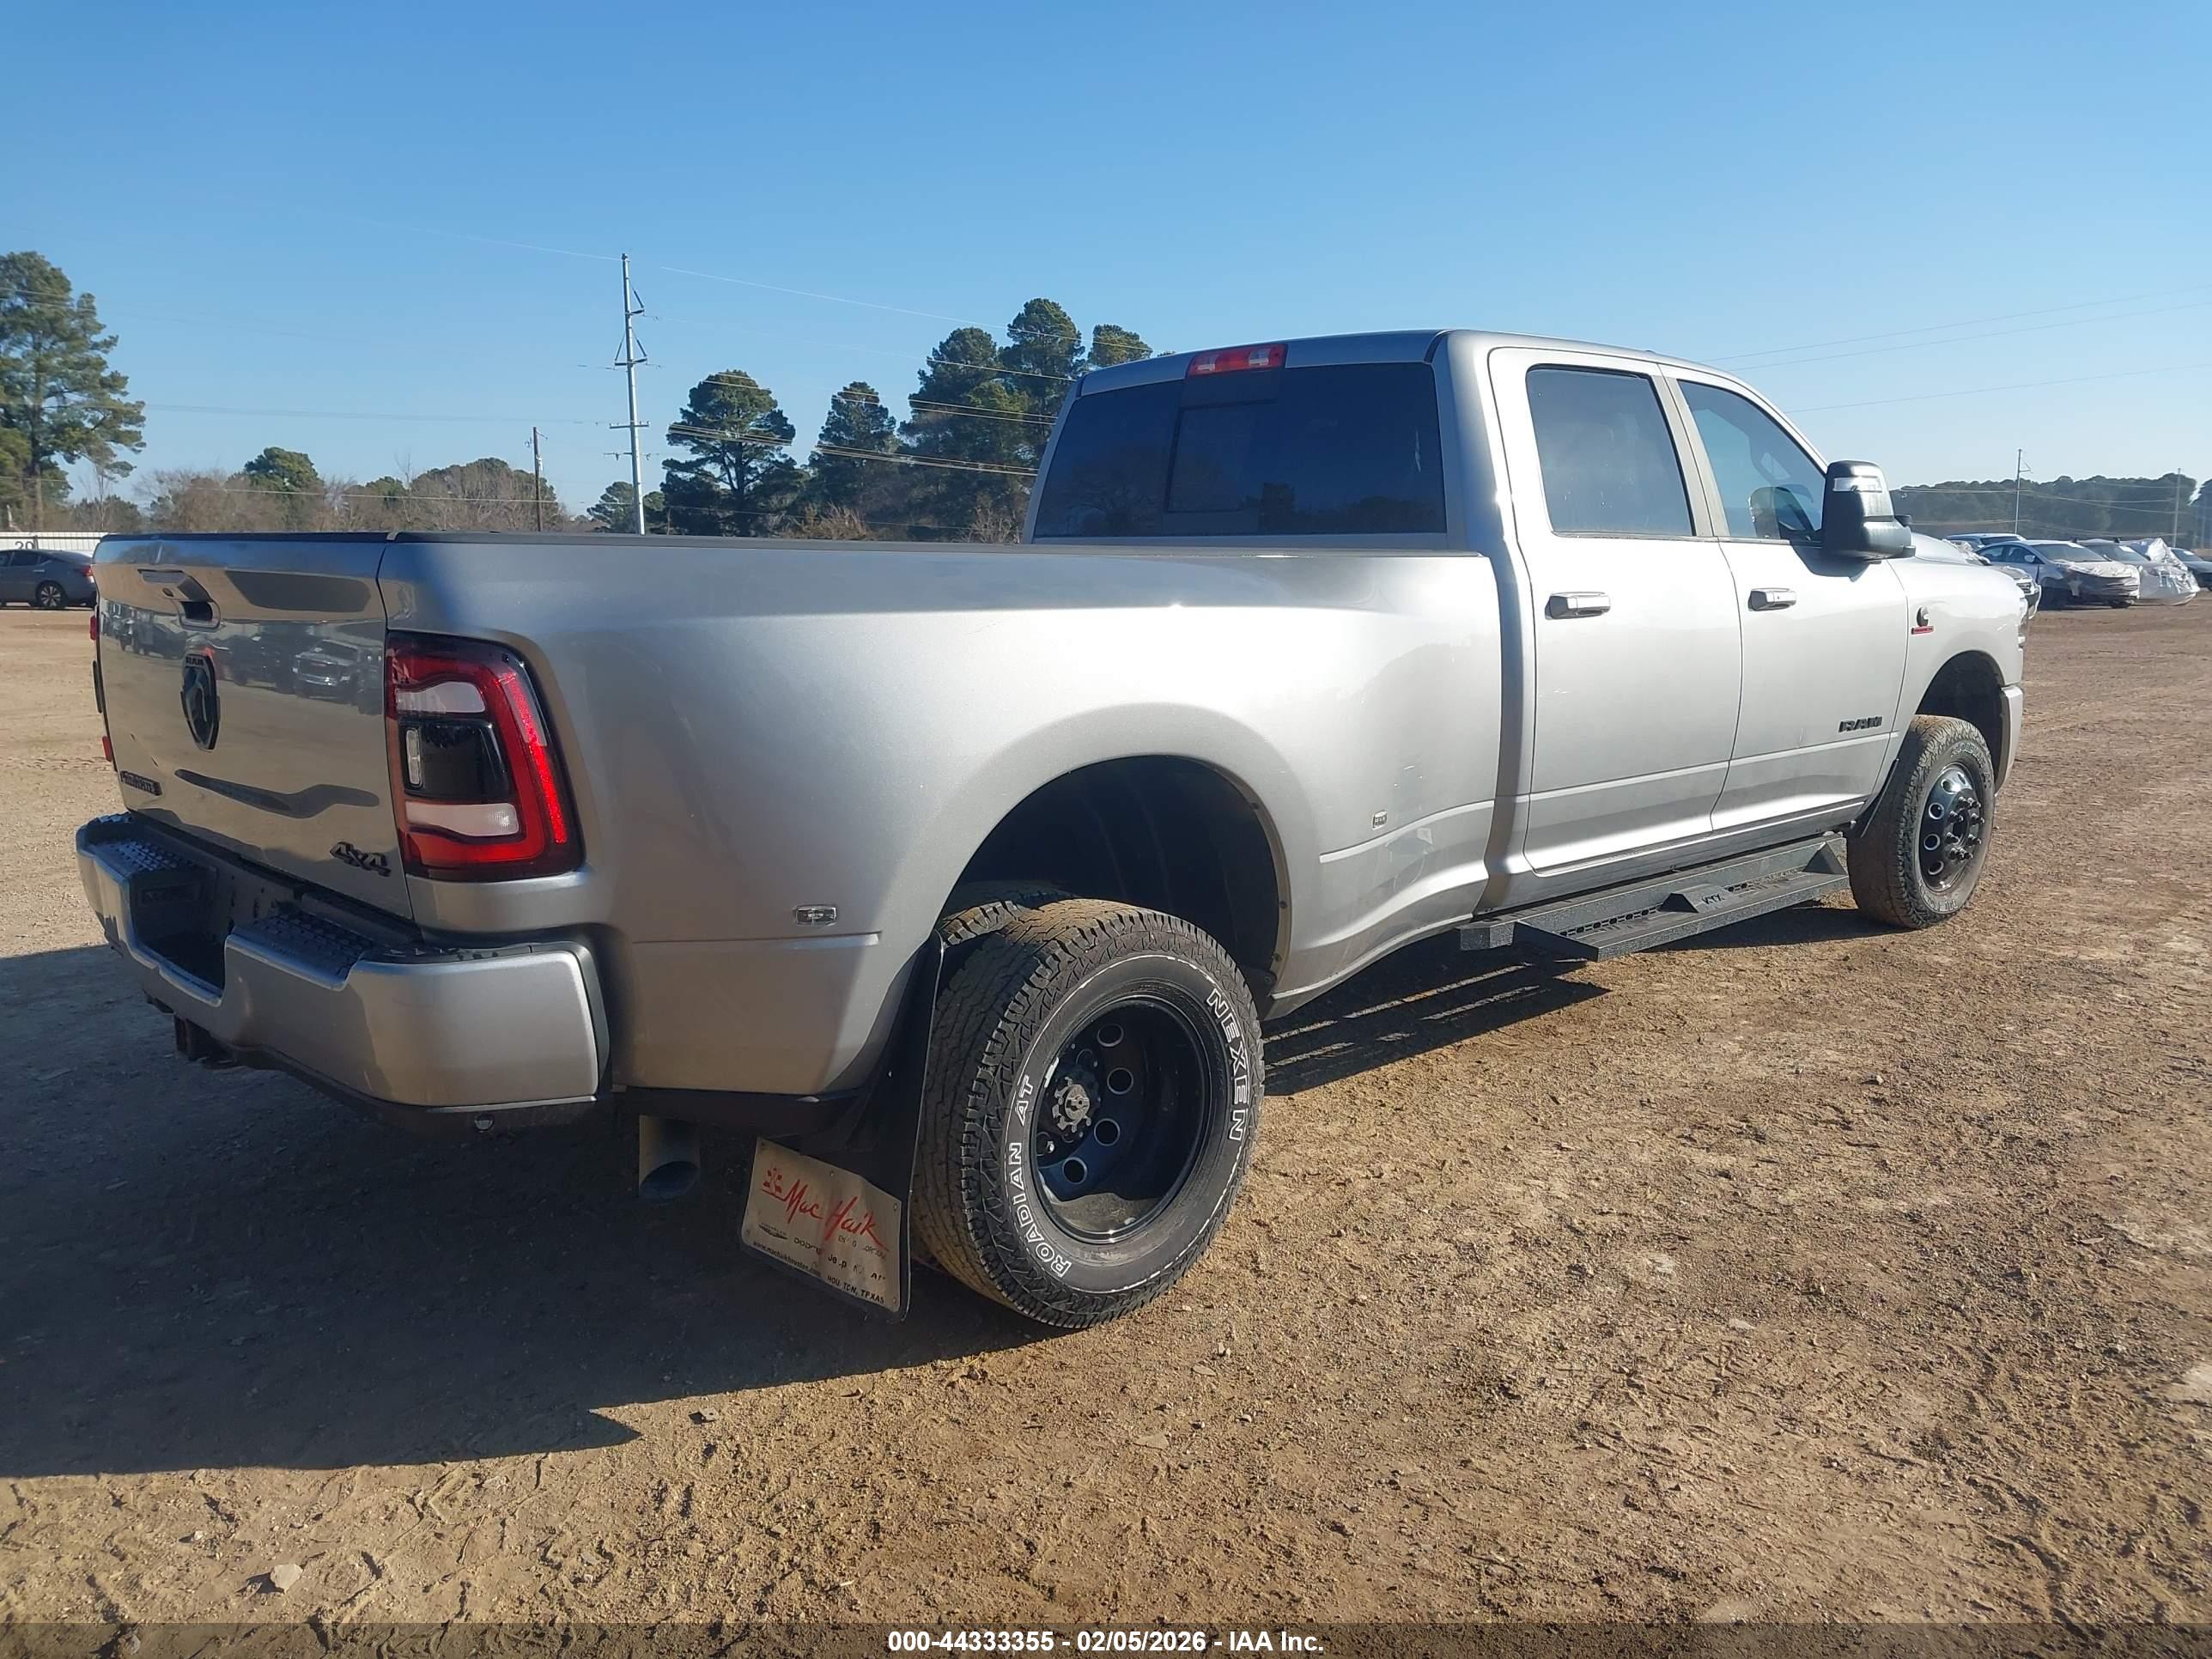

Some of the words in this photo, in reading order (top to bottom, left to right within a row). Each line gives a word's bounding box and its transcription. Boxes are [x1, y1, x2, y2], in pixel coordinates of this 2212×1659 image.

[1838, 716, 1883, 733] RAM
[1207, 988, 1249, 1141] NEXEN
[1018, 1075, 1034, 1127] AT
[769, 1180, 823, 1224] Mac
[1009, 1143, 1072, 1278] ROADIAN
